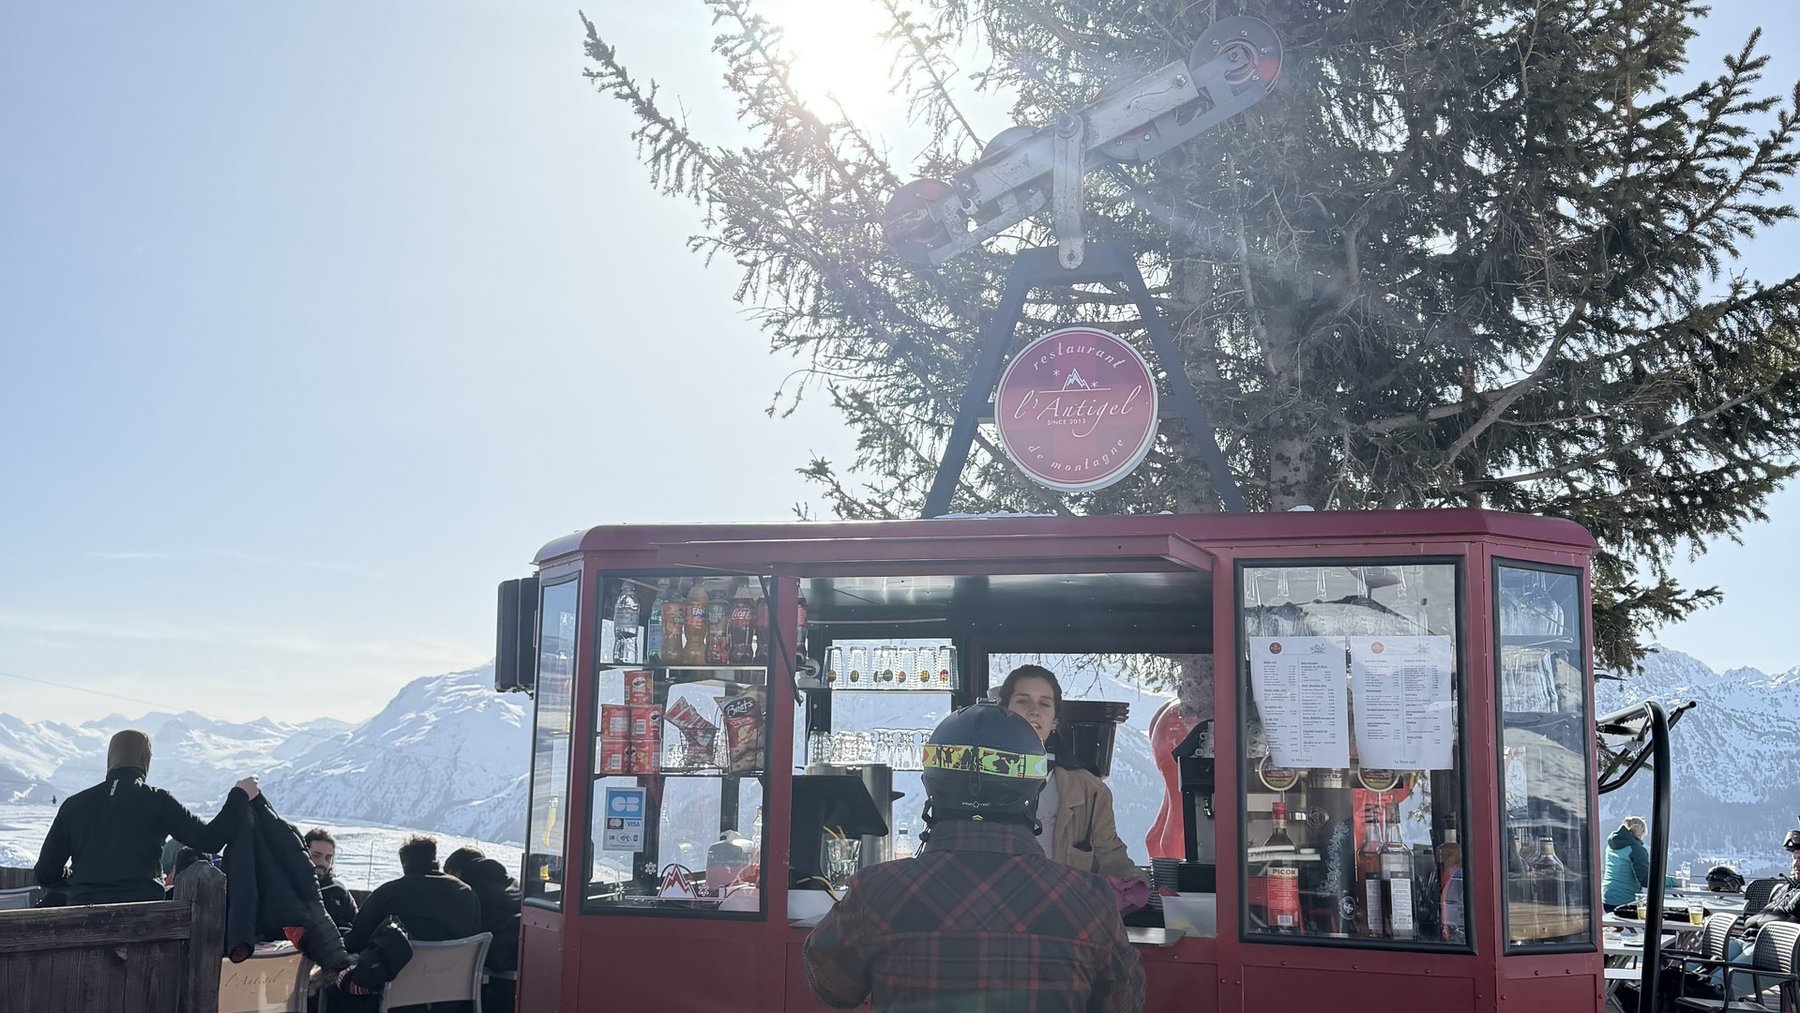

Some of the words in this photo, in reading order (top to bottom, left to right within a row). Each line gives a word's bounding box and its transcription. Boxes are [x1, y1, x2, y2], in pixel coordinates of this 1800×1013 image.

[1032, 342, 1126, 370] restaurant
[1014, 385, 1142, 438] l'Antigel
[1028, 445, 1044, 461] de
[1051, 439, 1124, 471] montagne
